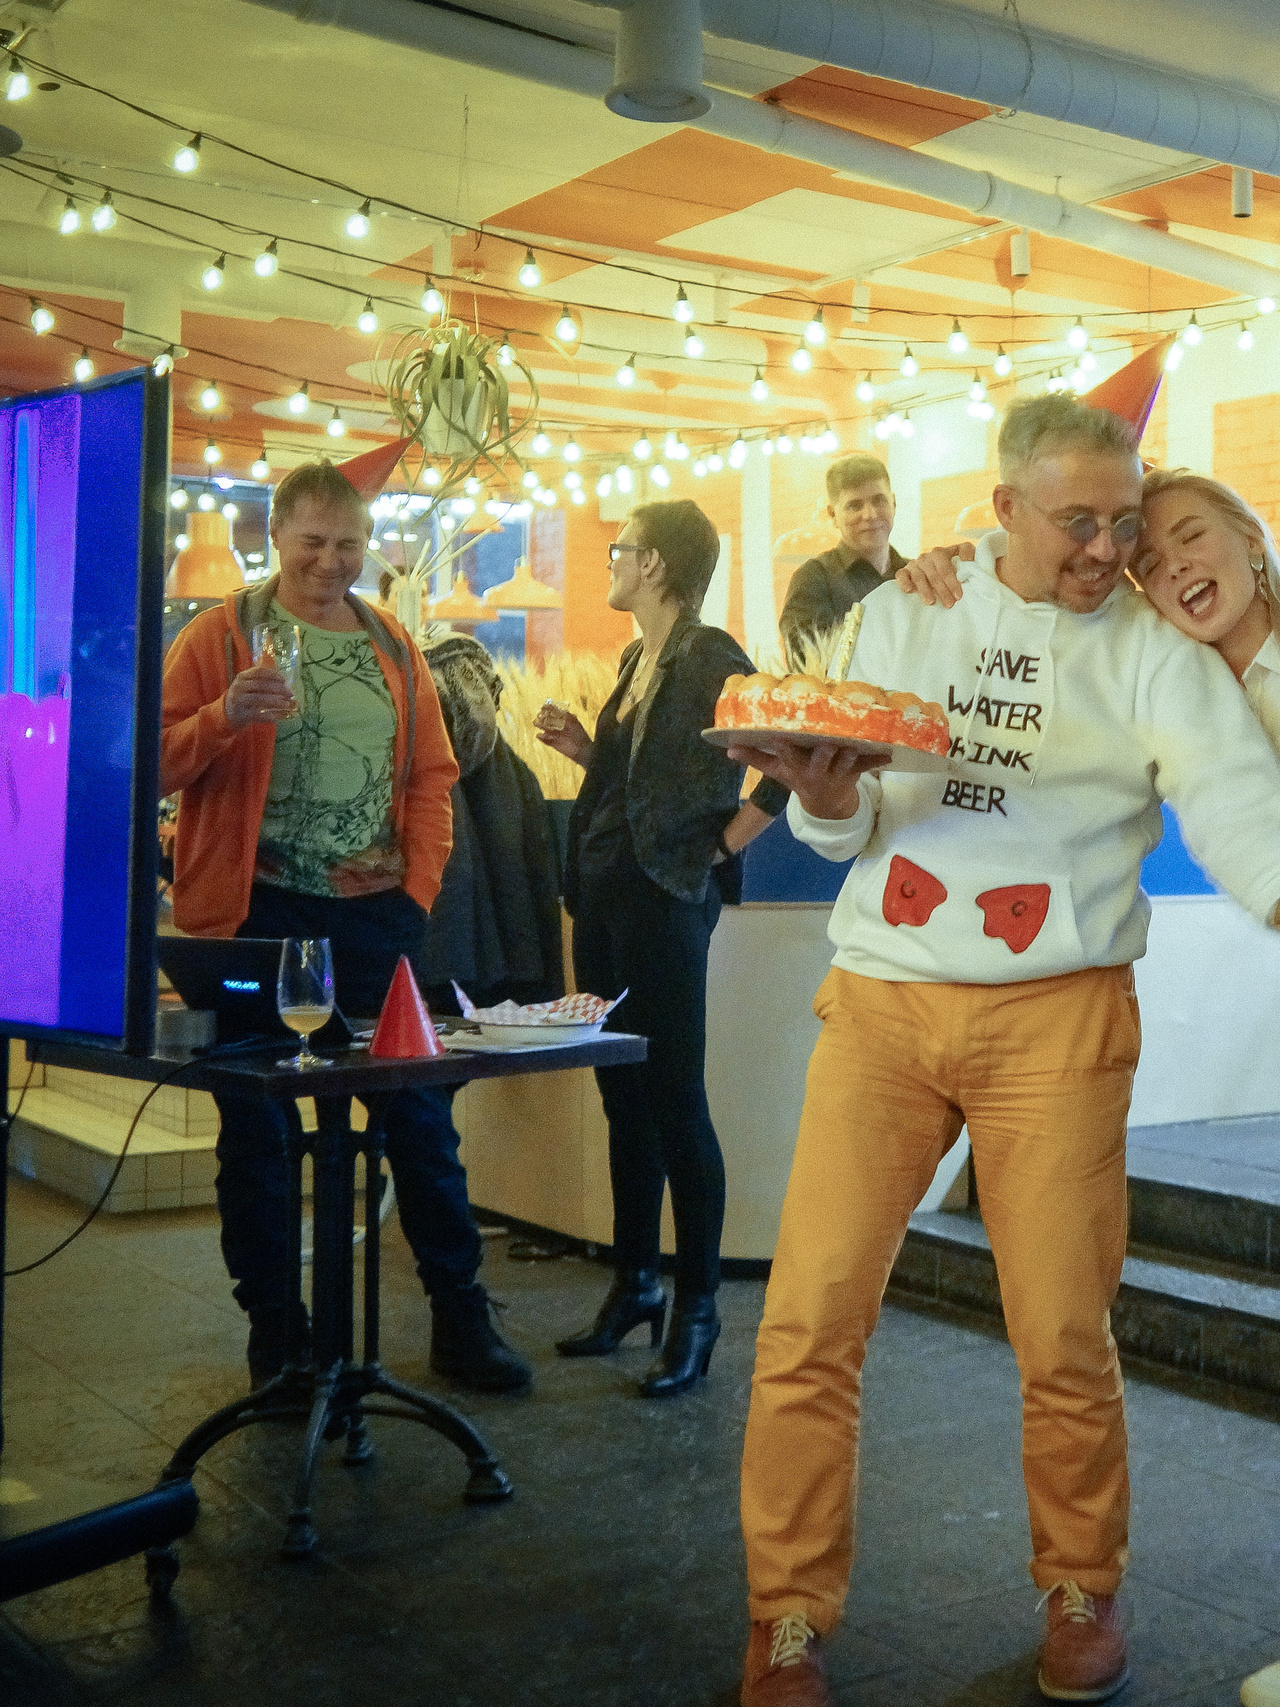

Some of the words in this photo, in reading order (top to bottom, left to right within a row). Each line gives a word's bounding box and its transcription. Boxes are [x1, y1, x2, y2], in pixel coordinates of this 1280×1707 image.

[975, 647, 1041, 683] SAVE
[948, 684, 1042, 733] WATER
[949, 736, 1033, 772] RINK
[941, 779, 1008, 817] BEER
